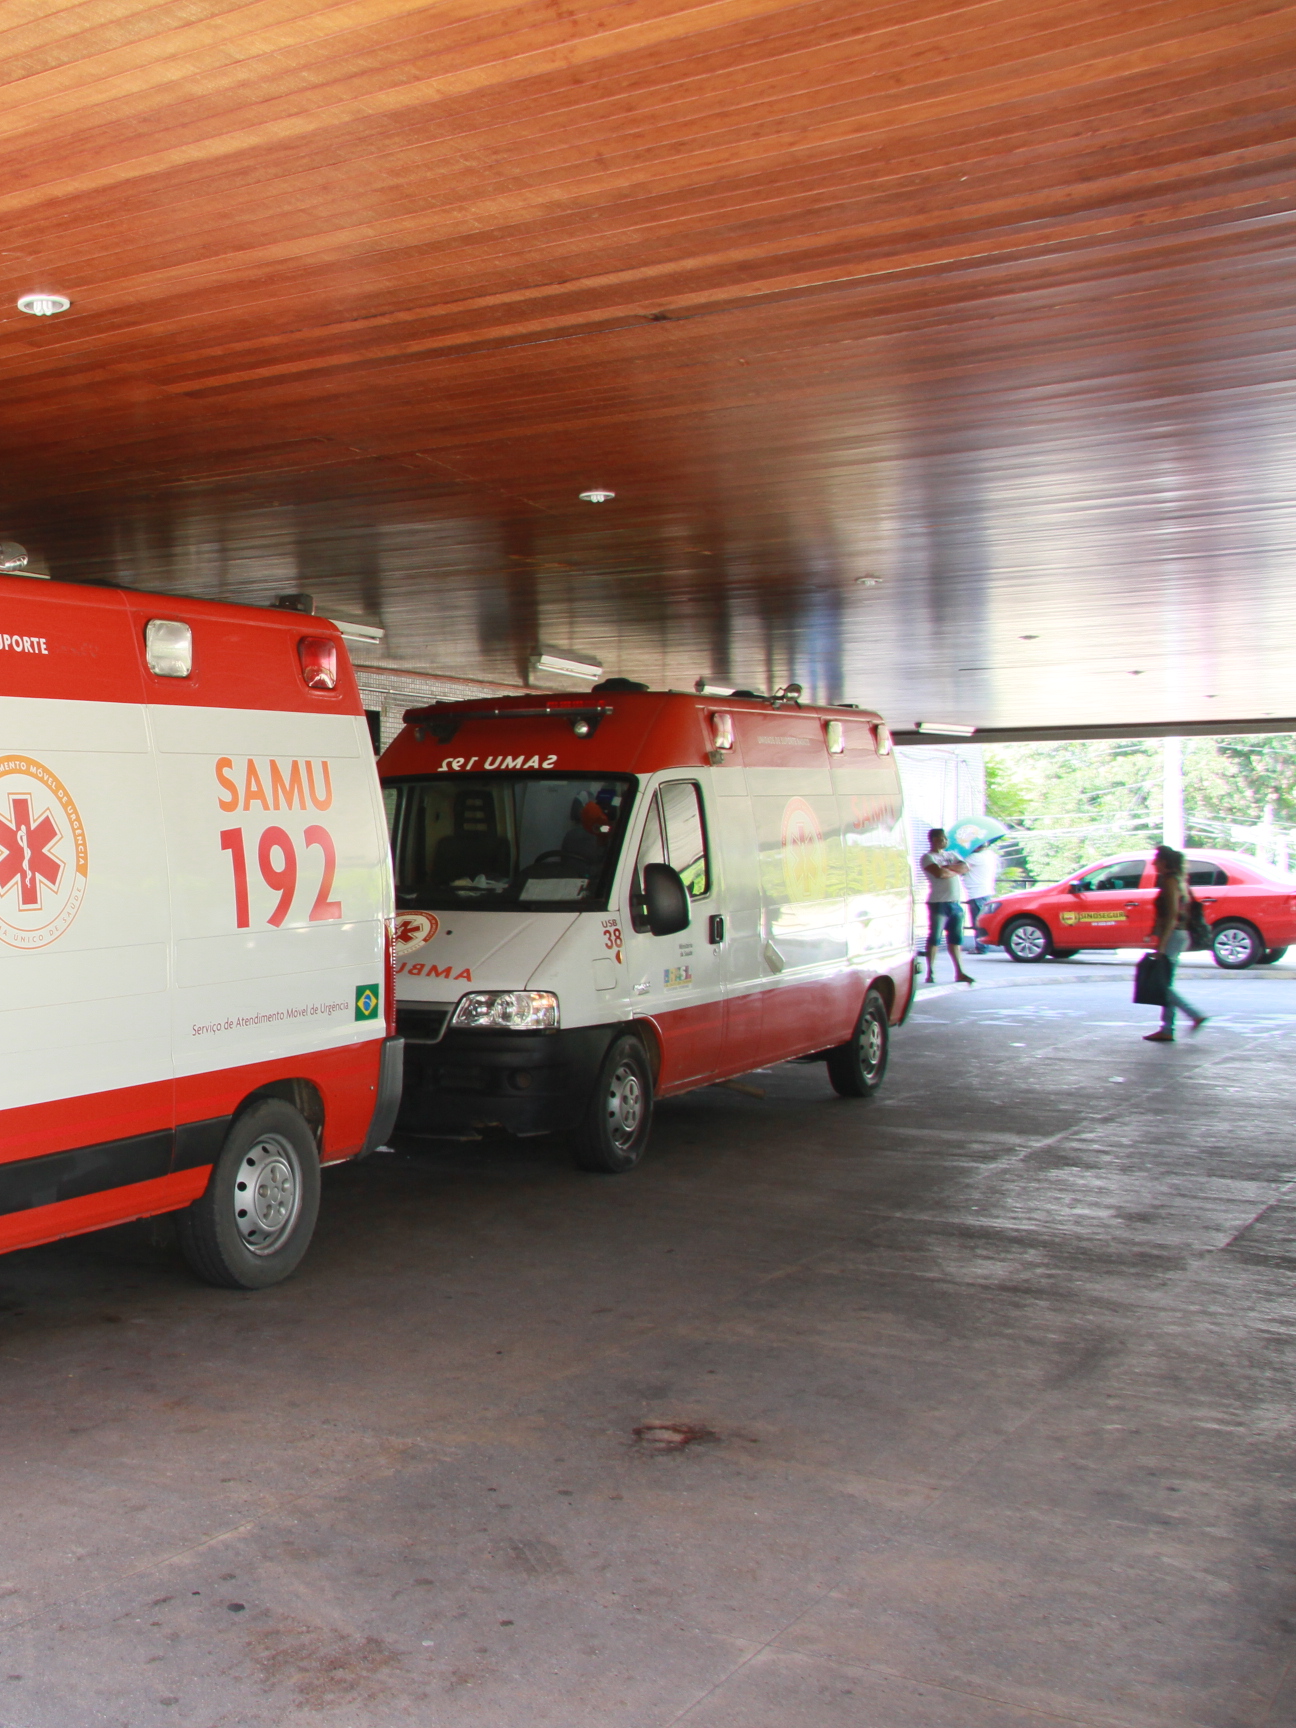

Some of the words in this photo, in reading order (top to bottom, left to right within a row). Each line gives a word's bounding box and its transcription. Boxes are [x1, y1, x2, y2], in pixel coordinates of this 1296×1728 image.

[215, 756, 333, 813] SAMU
[30, 764, 57, 790] MÓVEL
[57, 790, 68, 804] DE
[67, 805, 85, 866] URGÊNCIA
[220, 824, 342, 929] 192
[13, 932, 44, 943] ÚNICO
[49, 925, 60, 937] DE
[62, 887, 82, 924] SAÚDE
[601, 919, 618, 929] USB
[603, 928, 623, 950] 38
[192, 1021, 222, 1036] Serviço
[223, 1018, 234, 1030] de
[235, 1010, 285, 1029] Atendimento
[286, 1004, 308, 1020] Móvel
[309, 1003, 319, 1016] de
[320, 1000, 349, 1017] Urgência
